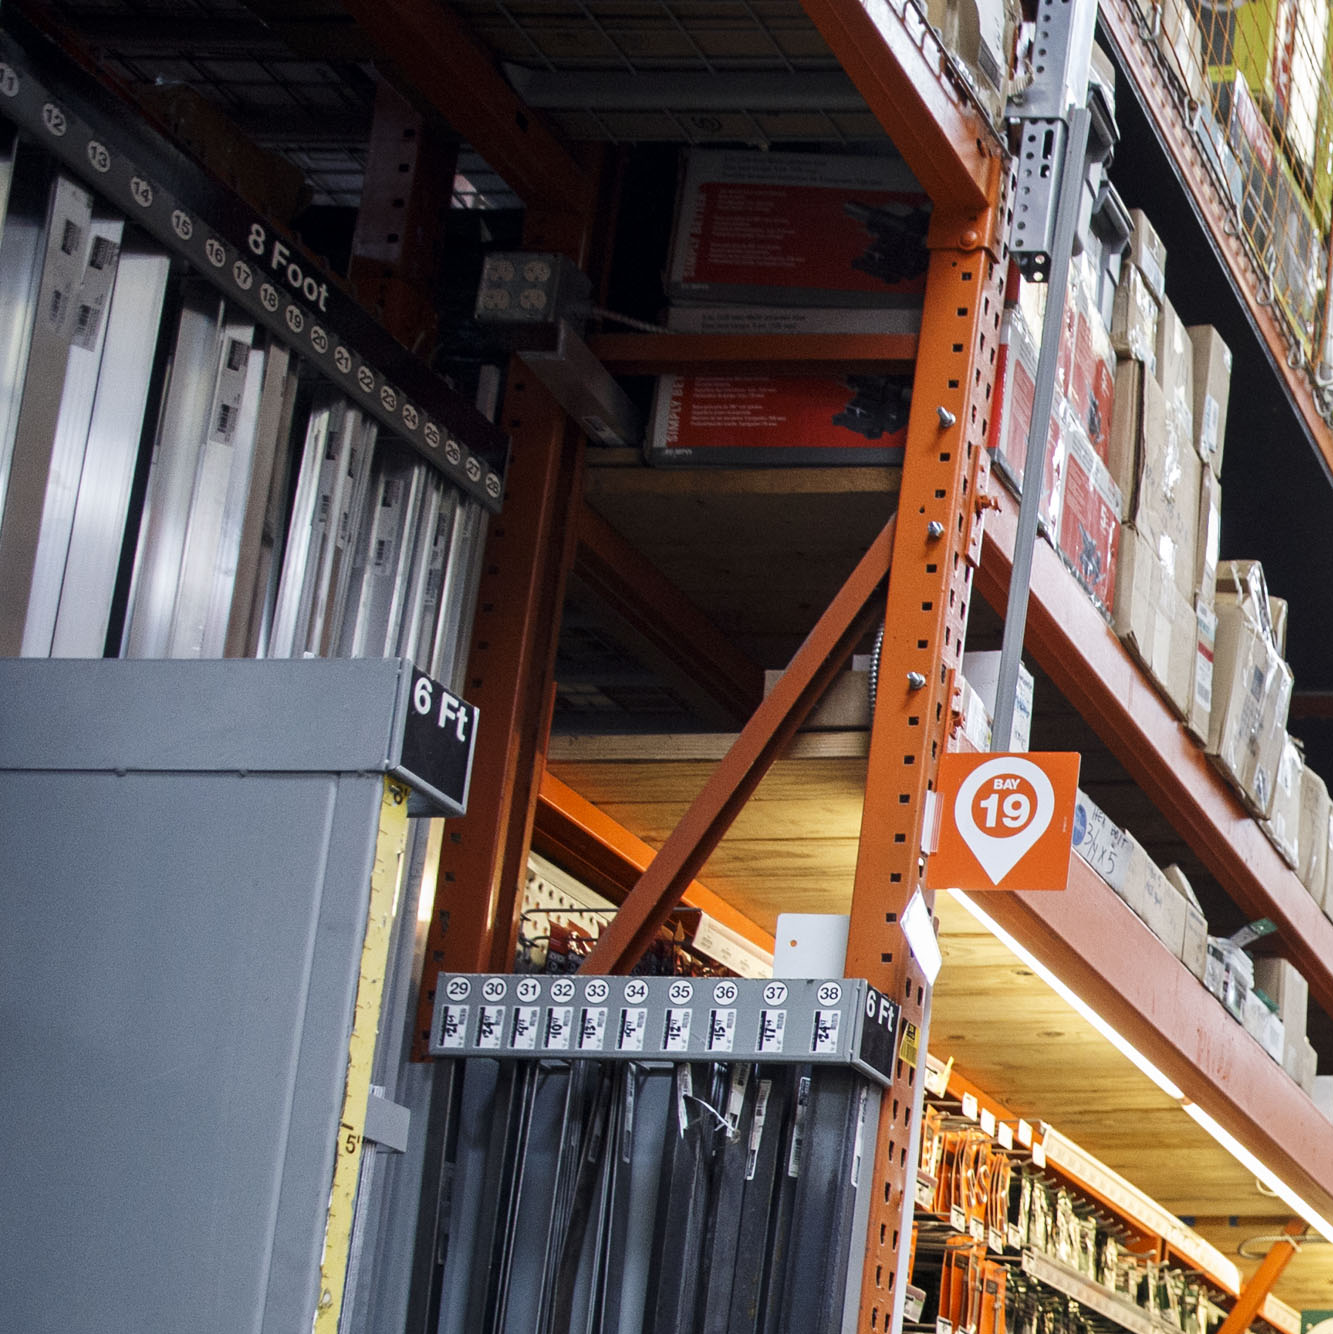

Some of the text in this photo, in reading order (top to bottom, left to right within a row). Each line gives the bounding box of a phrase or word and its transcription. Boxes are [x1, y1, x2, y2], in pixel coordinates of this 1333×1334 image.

[45, 108, 64, 133] 12
[90, 145, 108, 168] 13
[133, 180, 150, 203] 14
[174, 214, 191, 235] 15
[207, 243, 224, 264] 16
[235, 265, 251, 286] 17
[249, 223, 329, 312] 8 Foot
[262, 286, 278, 308] 18
[288, 310, 303, 329] 19
[312, 330, 328, 350] 20
[336, 351, 351, 370] 21
[359, 371, 374, 390] 22
[381, 390, 397, 409] 23
[404, 408, 418, 427] 24
[425, 427, 439, 445] 25
[467, 462, 480, 478] 27
[412, 677, 469, 743] 6 Ft
[993, 779, 1020, 790] BAY
[980, 793, 1031, 828] 19
[450, 982, 468, 995] 29
[485, 982, 504, 996] 30
[519, 983, 537, 996] 31
[553, 983, 572, 997] 32
[587, 984, 606, 997] 33
[626, 985, 645, 998] 34
[671, 986, 690, 998] 35
[716, 987, 735, 999] 36
[766, 987, 785, 1000] 37
[820, 988, 839, 1000] 38
[866, 990, 895, 1032] 6 Ft
